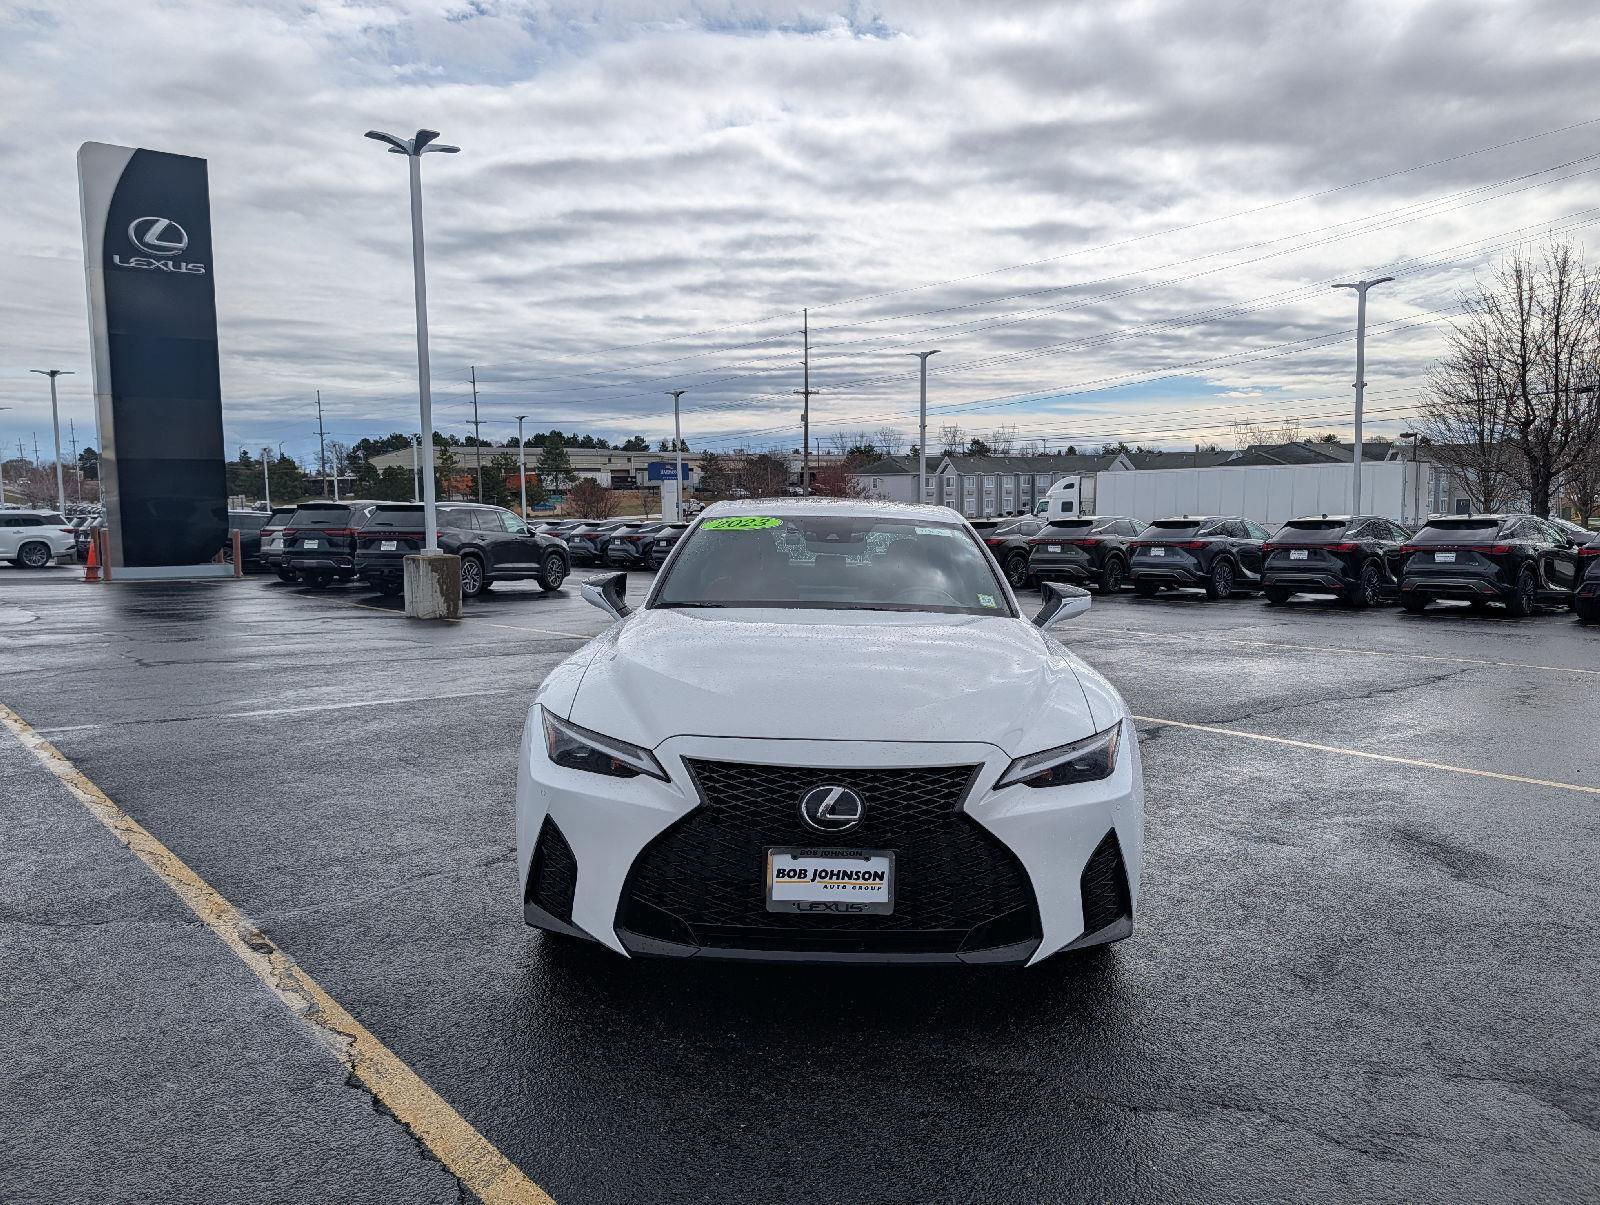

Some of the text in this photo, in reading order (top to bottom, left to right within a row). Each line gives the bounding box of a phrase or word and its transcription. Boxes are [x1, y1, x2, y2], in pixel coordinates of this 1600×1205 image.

[113, 255, 206, 275] LEXUS
[712, 518, 769, 528] 2023
[800, 849, 818, 857] BOB
[775, 868, 885, 882] BOB JOHNSON
[797, 903, 864, 913] LEXUS
